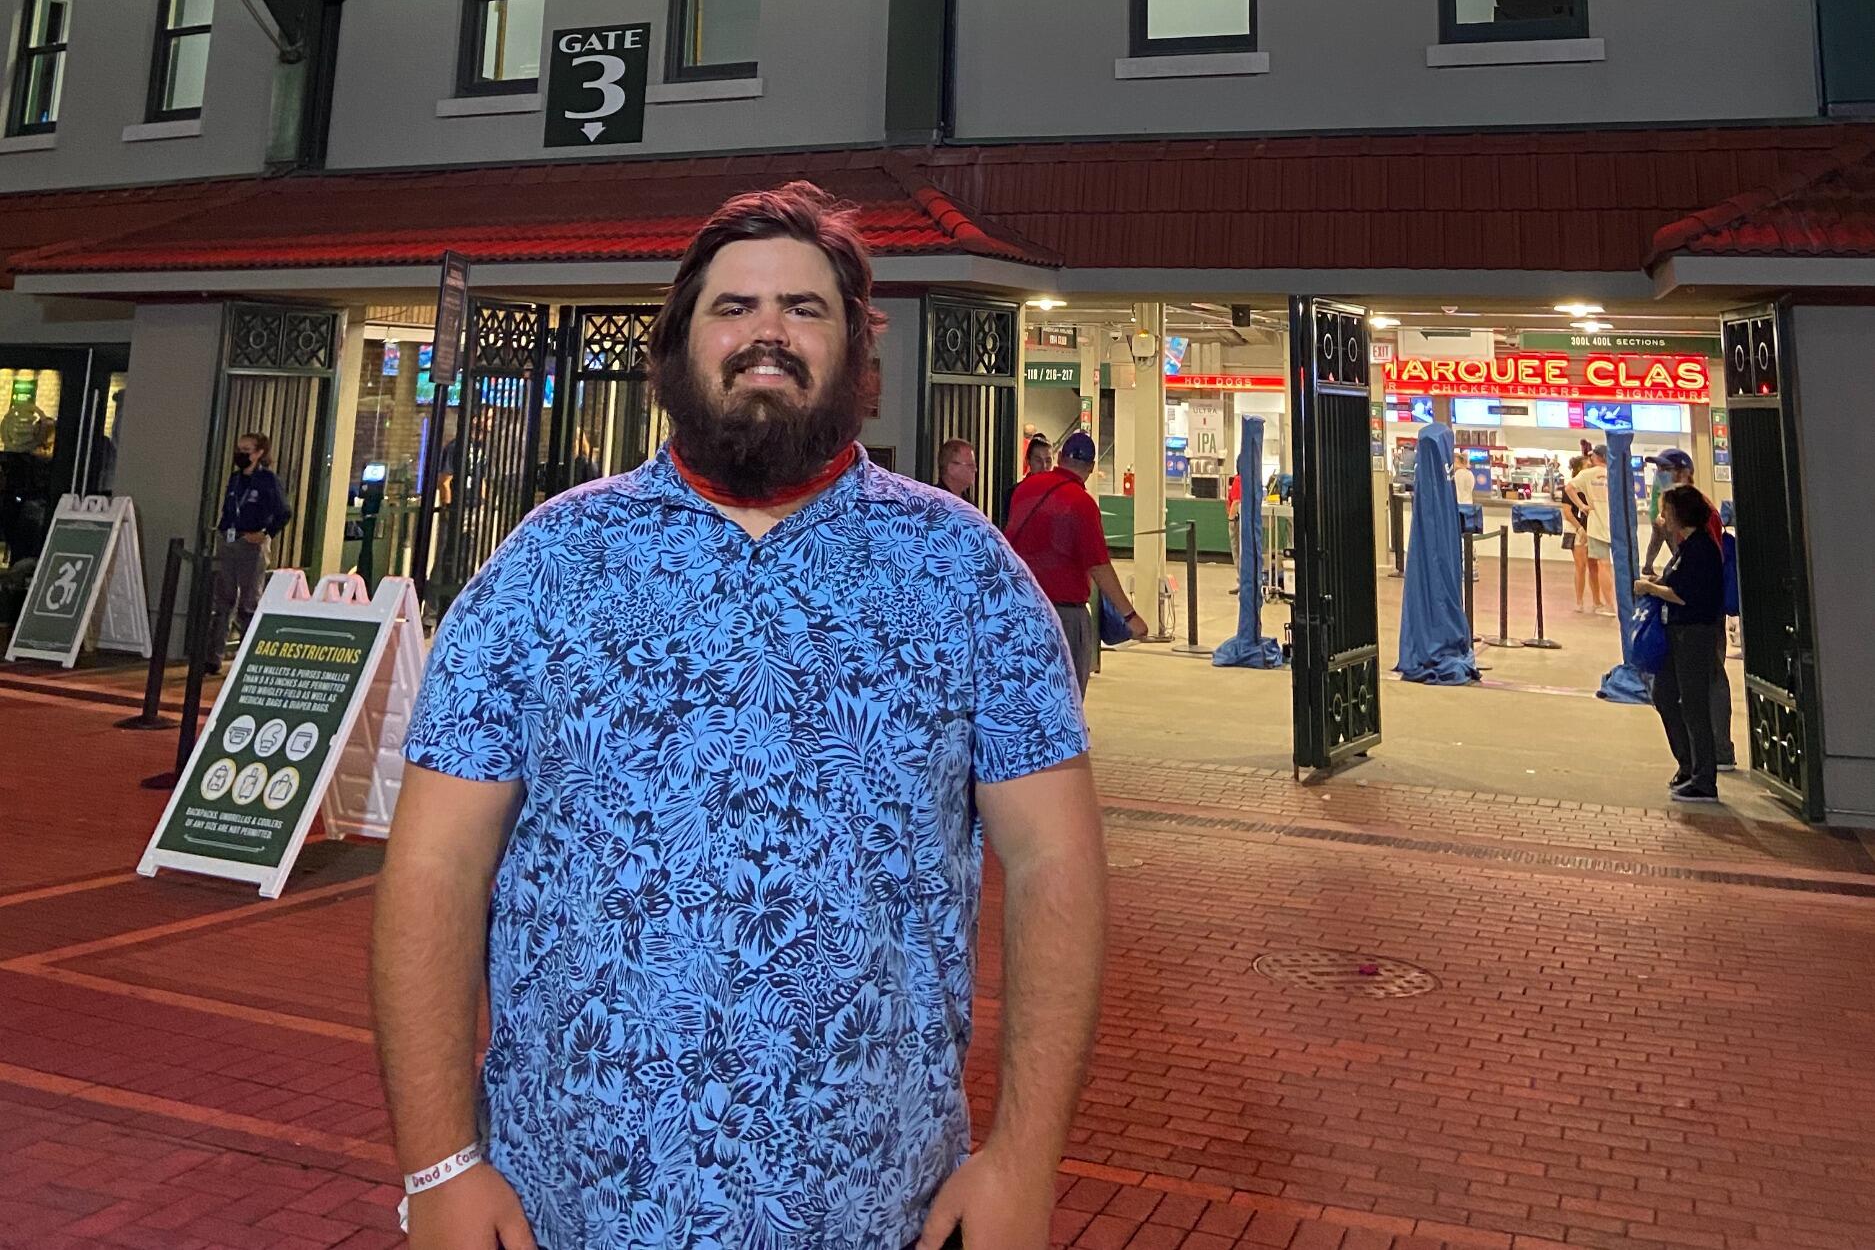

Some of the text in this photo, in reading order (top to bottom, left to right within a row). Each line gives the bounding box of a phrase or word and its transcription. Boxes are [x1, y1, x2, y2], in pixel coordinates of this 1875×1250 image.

[559, 29, 643, 53] GATE
[564, 55, 626, 119] 3
[1571, 336, 1666, 347] 300L 400L SECTIONS
[1373, 345, 1389, 357] EXIT
[1185, 377, 1252, 388] HOT DOGS
[1586, 361, 1709, 389] CLAS
[1431, 383, 1579, 397] CHICKEN TENDERS
[1615, 389, 1709, 401] SIGNATURE
[1198, 433, 1216, 453] IPA
[255, 640, 361, 664] BAG RESTRICTIONS
[321, 671, 350, 682] SMALLER
[412, 1166, 441, 1187] Dead
